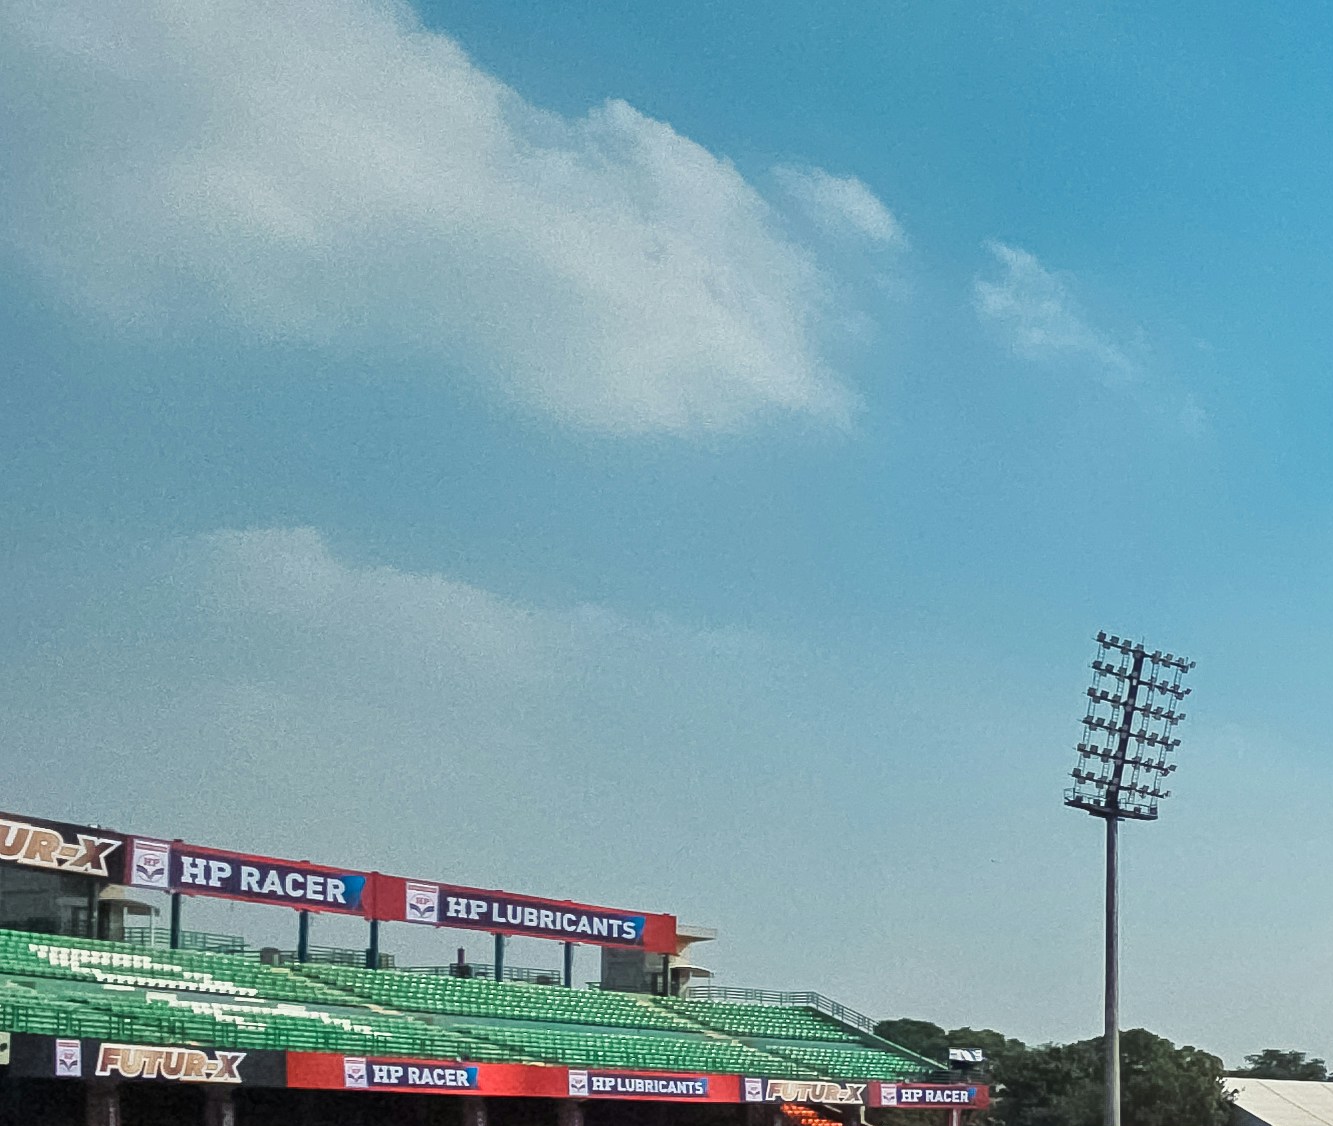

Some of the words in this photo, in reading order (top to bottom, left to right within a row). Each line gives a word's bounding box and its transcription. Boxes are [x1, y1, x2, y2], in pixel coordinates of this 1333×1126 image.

[180, 856, 232, 888] HP
[240, 866, 347, 904] RACER
[446, 897, 488, 919] HP
[492, 902, 637, 939] LUBRICANTS
[95, 1043, 248, 1084] FUTUR-X
[371, 1065, 404, 1084] HP
[408, 1066, 470, 1087] RACER
[591, 1076, 615, 1091] HP
[616, 1078, 704, 1095] LUBRICANTS
[766, 1080, 867, 1105] FUTUR-X
[901, 1089, 923, 1102] HP
[925, 1089, 969, 1103] RACER
